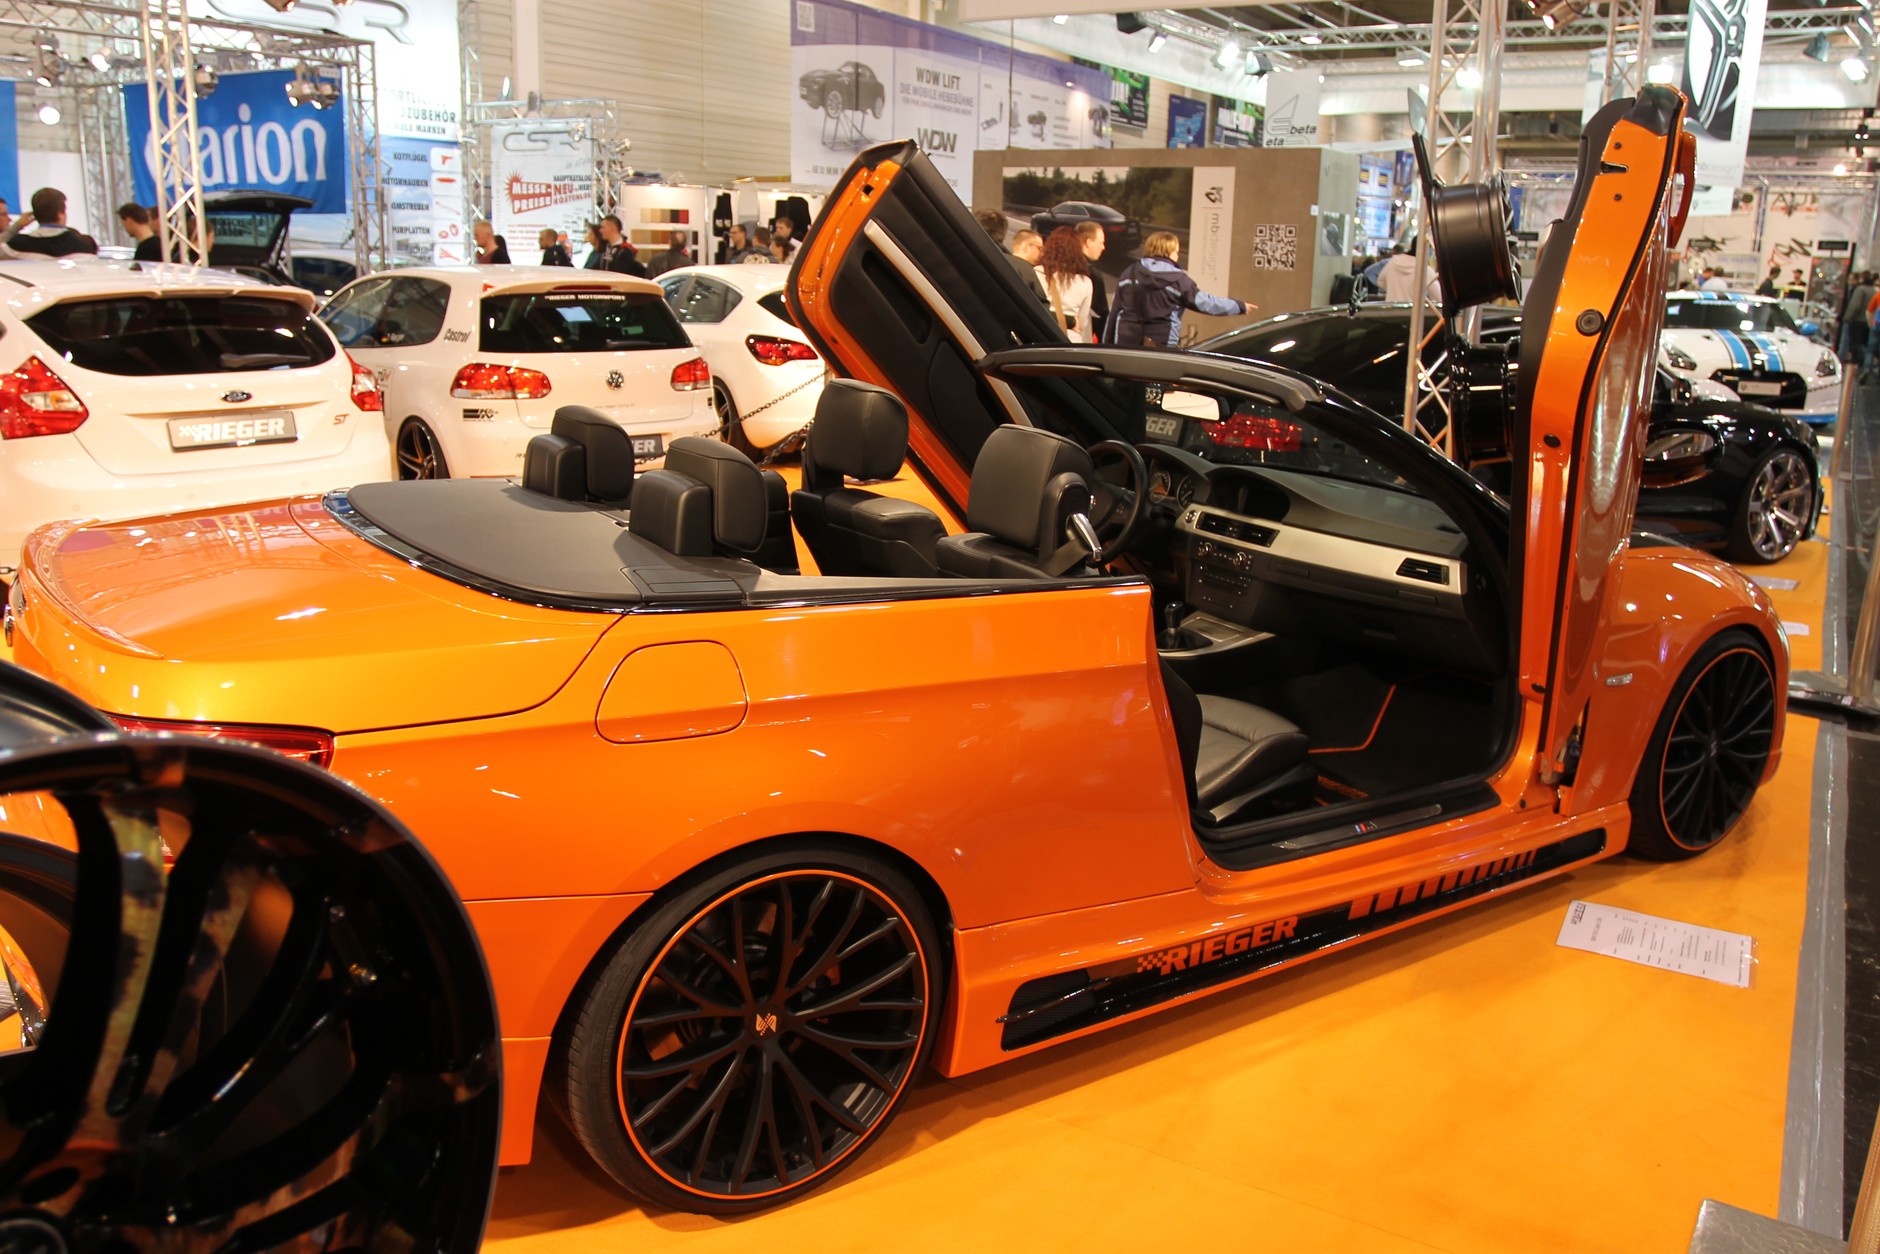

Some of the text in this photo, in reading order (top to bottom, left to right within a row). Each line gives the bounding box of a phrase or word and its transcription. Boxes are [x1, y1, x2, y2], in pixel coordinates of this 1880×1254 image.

[916, 67, 960, 90] WDW LIFT
[1290, 125, 1317, 135] beta
[917, 127, 957, 152] WDW
[1266, 136, 1284, 146] eta
[512, 182, 551, 195] MESSE-
[554, 184, 574, 196] NEU
[514, 197, 552, 214] PREISE
[192, 418, 285, 443] RIEGER
[1160, 916, 1299, 976] RIEGER
